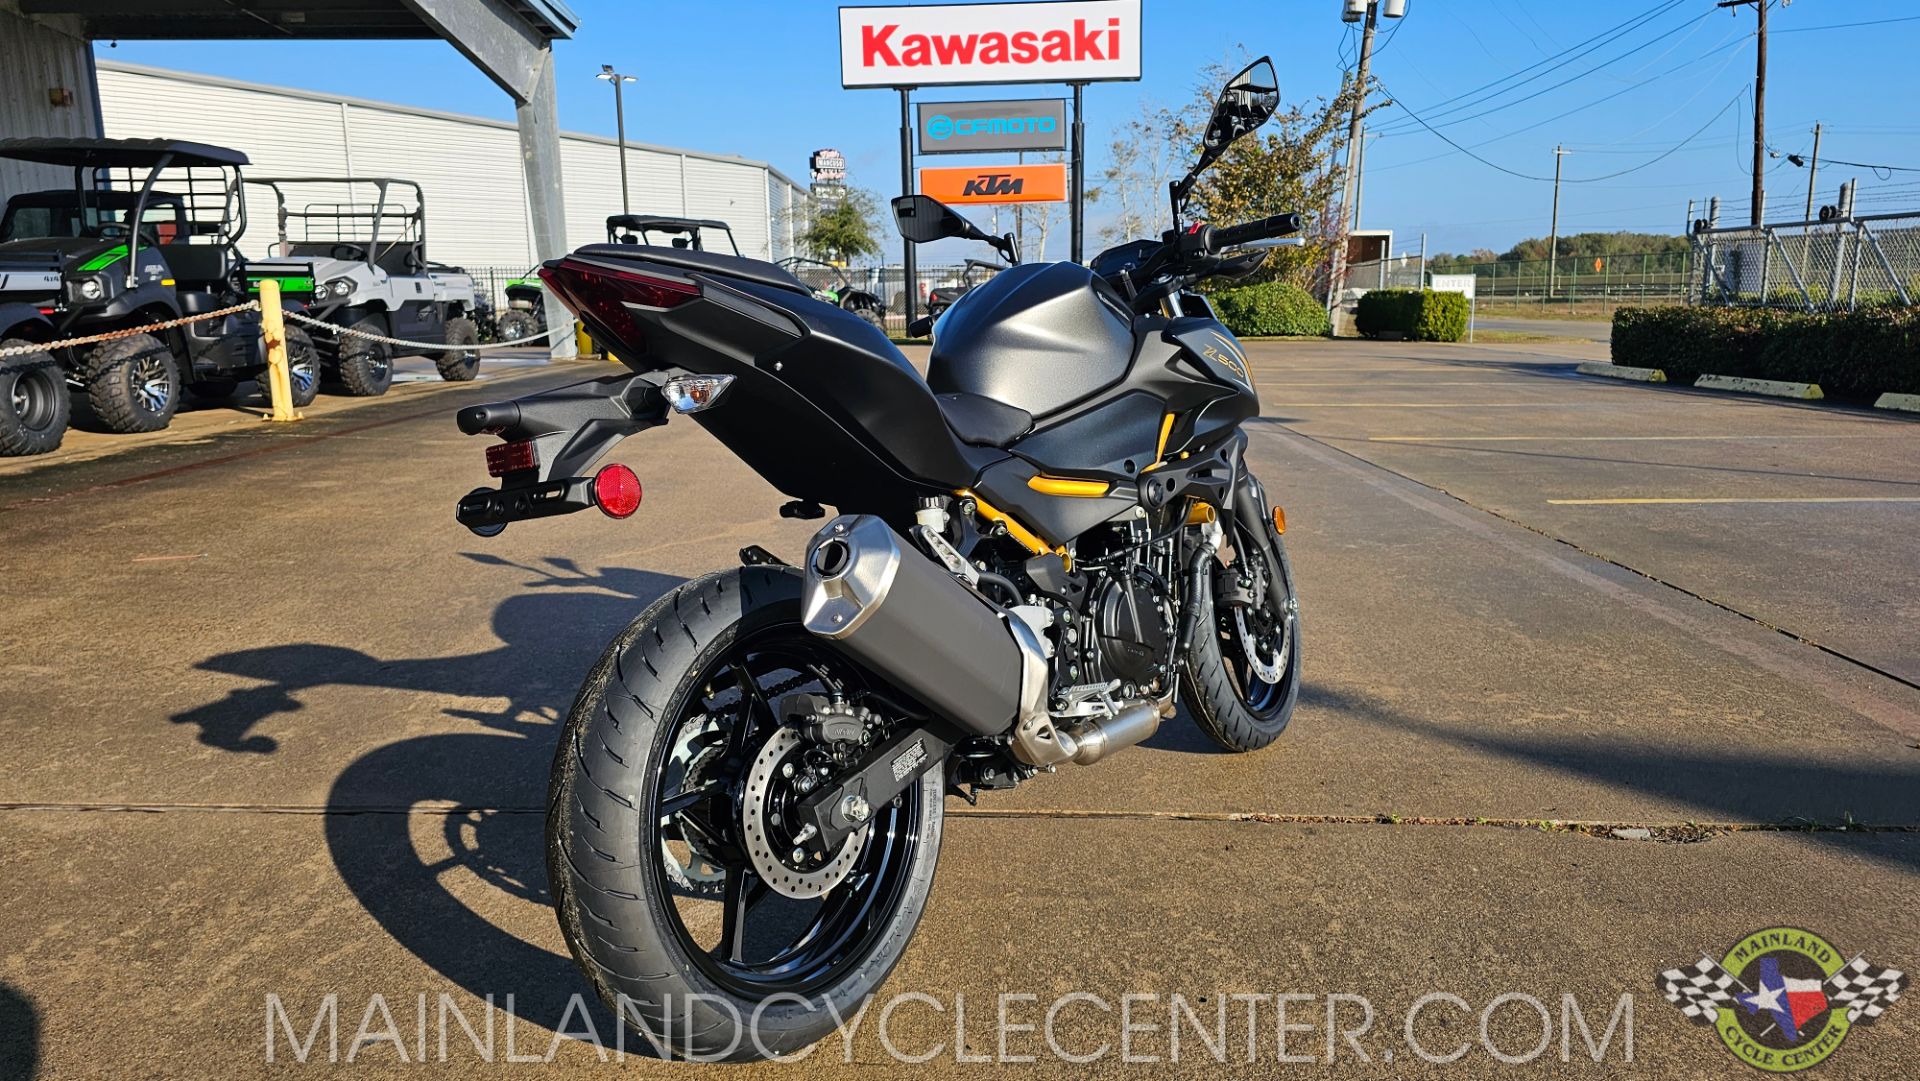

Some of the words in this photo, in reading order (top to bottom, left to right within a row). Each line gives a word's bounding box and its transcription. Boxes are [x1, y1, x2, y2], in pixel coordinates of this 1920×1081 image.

[861, 17, 1120, 67] Kawasaki
[955, 116, 1057, 136] CFMOTO
[962, 174, 1024, 197] KTM
[1435, 279, 1472, 288] ENTER
